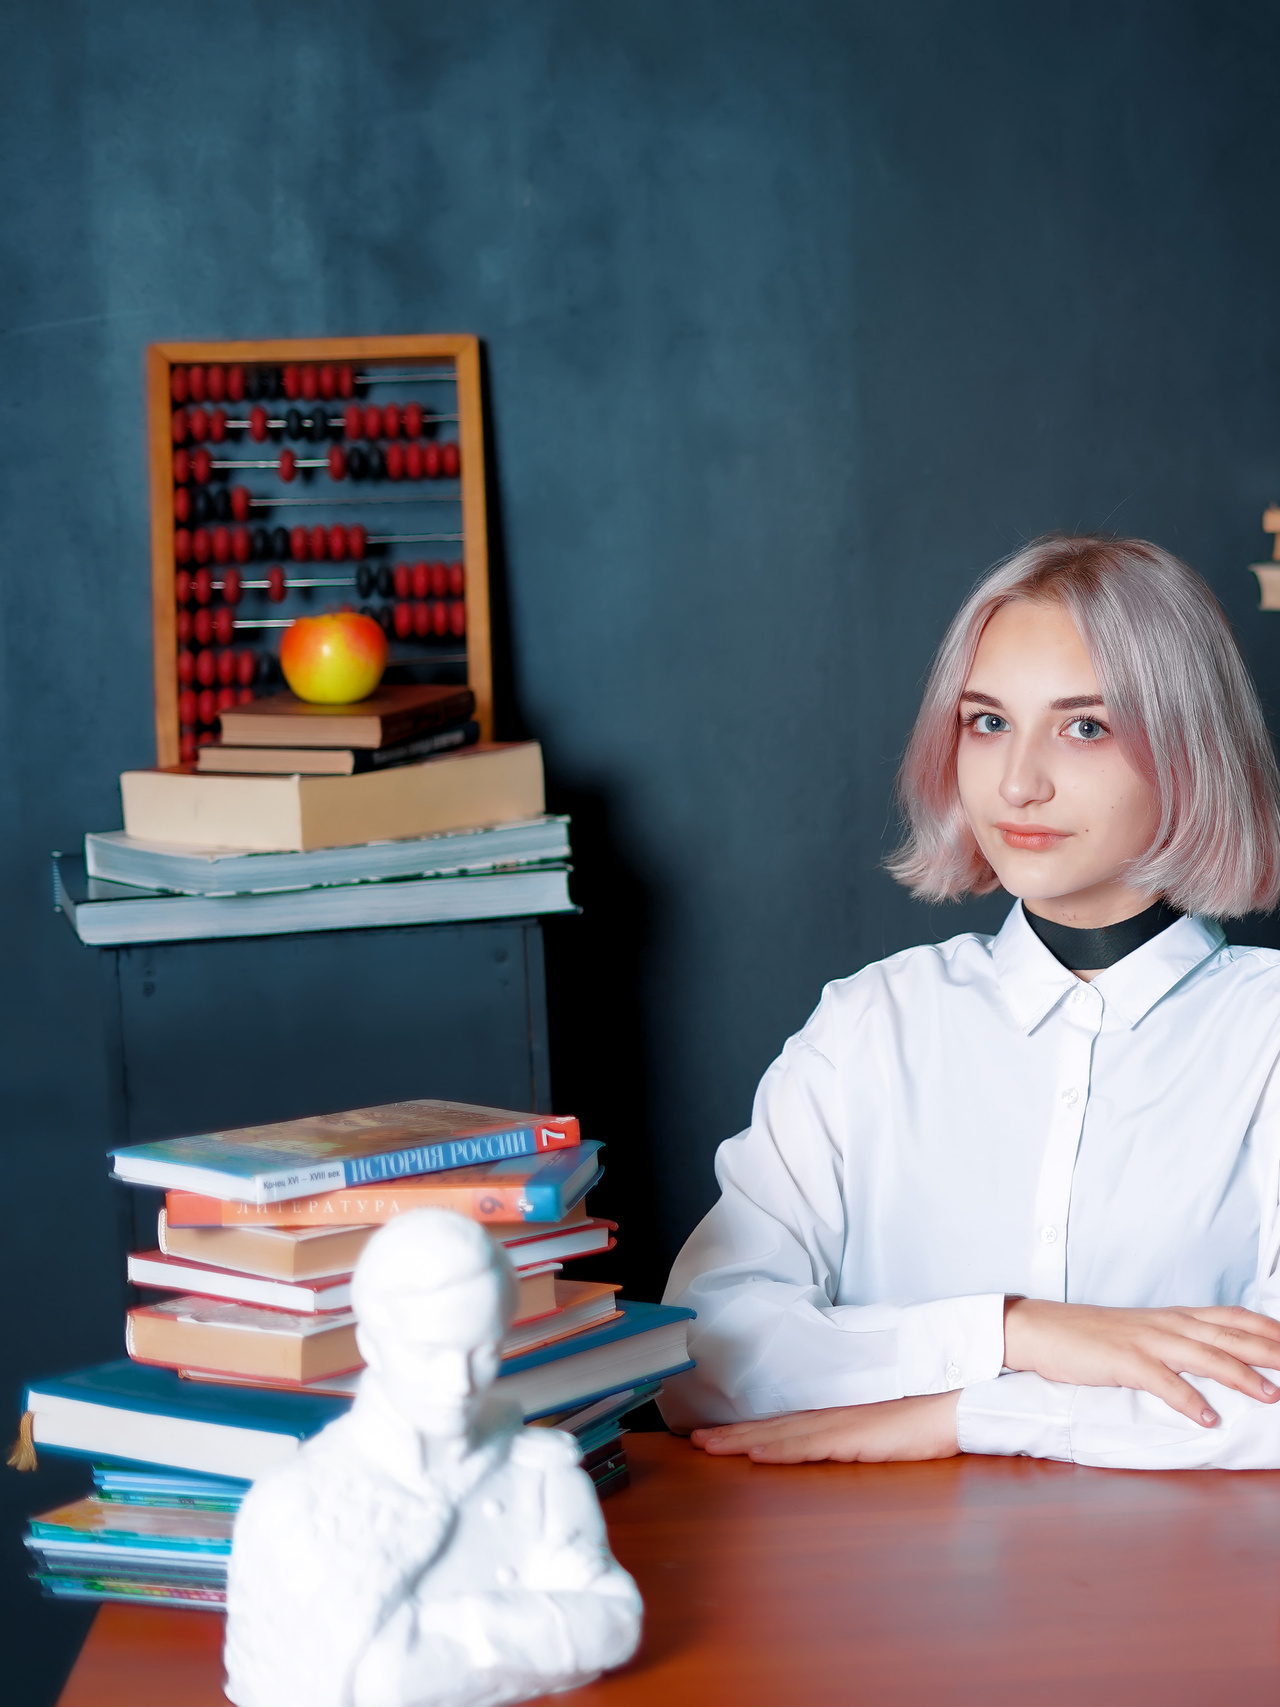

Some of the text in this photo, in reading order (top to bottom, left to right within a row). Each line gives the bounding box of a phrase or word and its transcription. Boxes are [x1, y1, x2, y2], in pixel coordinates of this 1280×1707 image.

[351, 1129, 566, 1182] ИСТОРИЯ РОССИИ 7
[263, 1179, 286, 1190] Конец
[287, 1176, 300, 1185] XVI
[309, 1172, 326, 1182] XVIII
[327, 1170, 341, 1179] век
[237, 1199, 400, 1214] ЛИТЕРАТУРА
